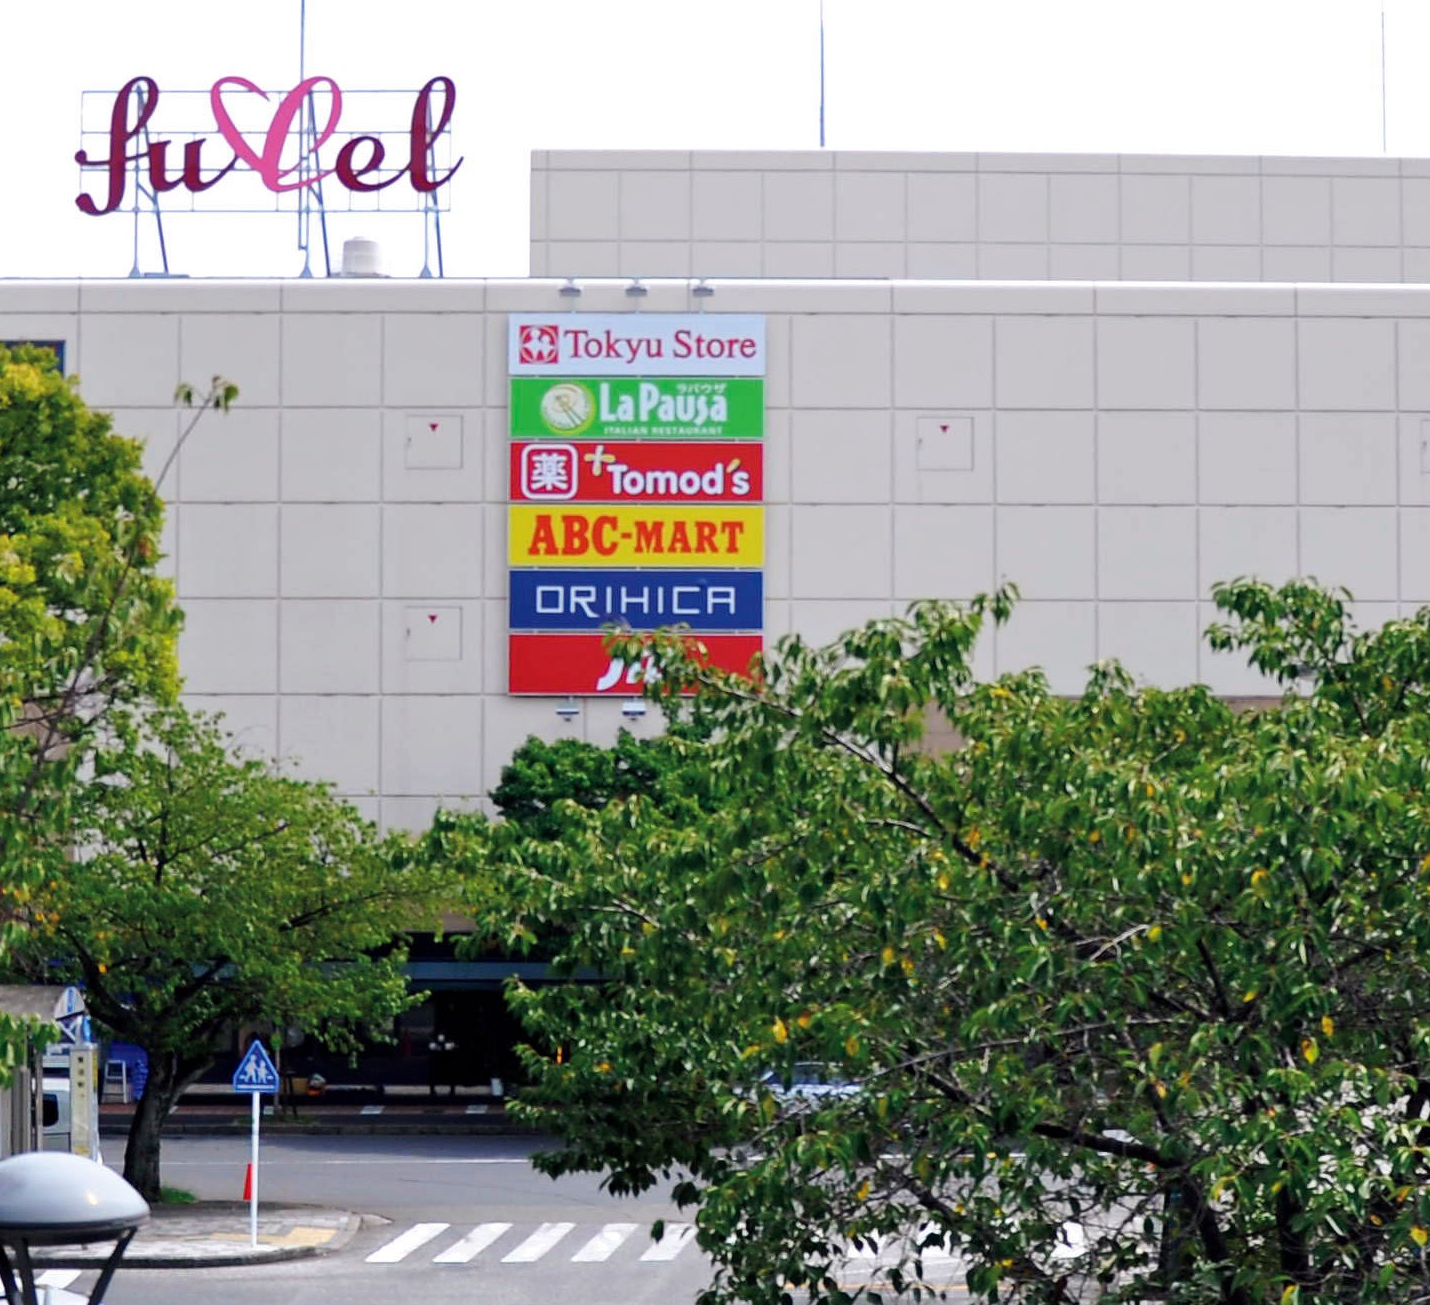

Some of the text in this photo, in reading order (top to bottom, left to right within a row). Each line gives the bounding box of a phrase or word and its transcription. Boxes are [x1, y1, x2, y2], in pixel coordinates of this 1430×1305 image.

[564, 329, 757, 364] Tokyu Store
[603, 426, 723, 435] ITALIAN RESTAURANT
[530, 452, 569, 491] 薬
[606, 458, 751, 495] Tomod's
[528, 514, 745, 556] ABC-MART
[535, 585, 736, 618] ORIHICA
